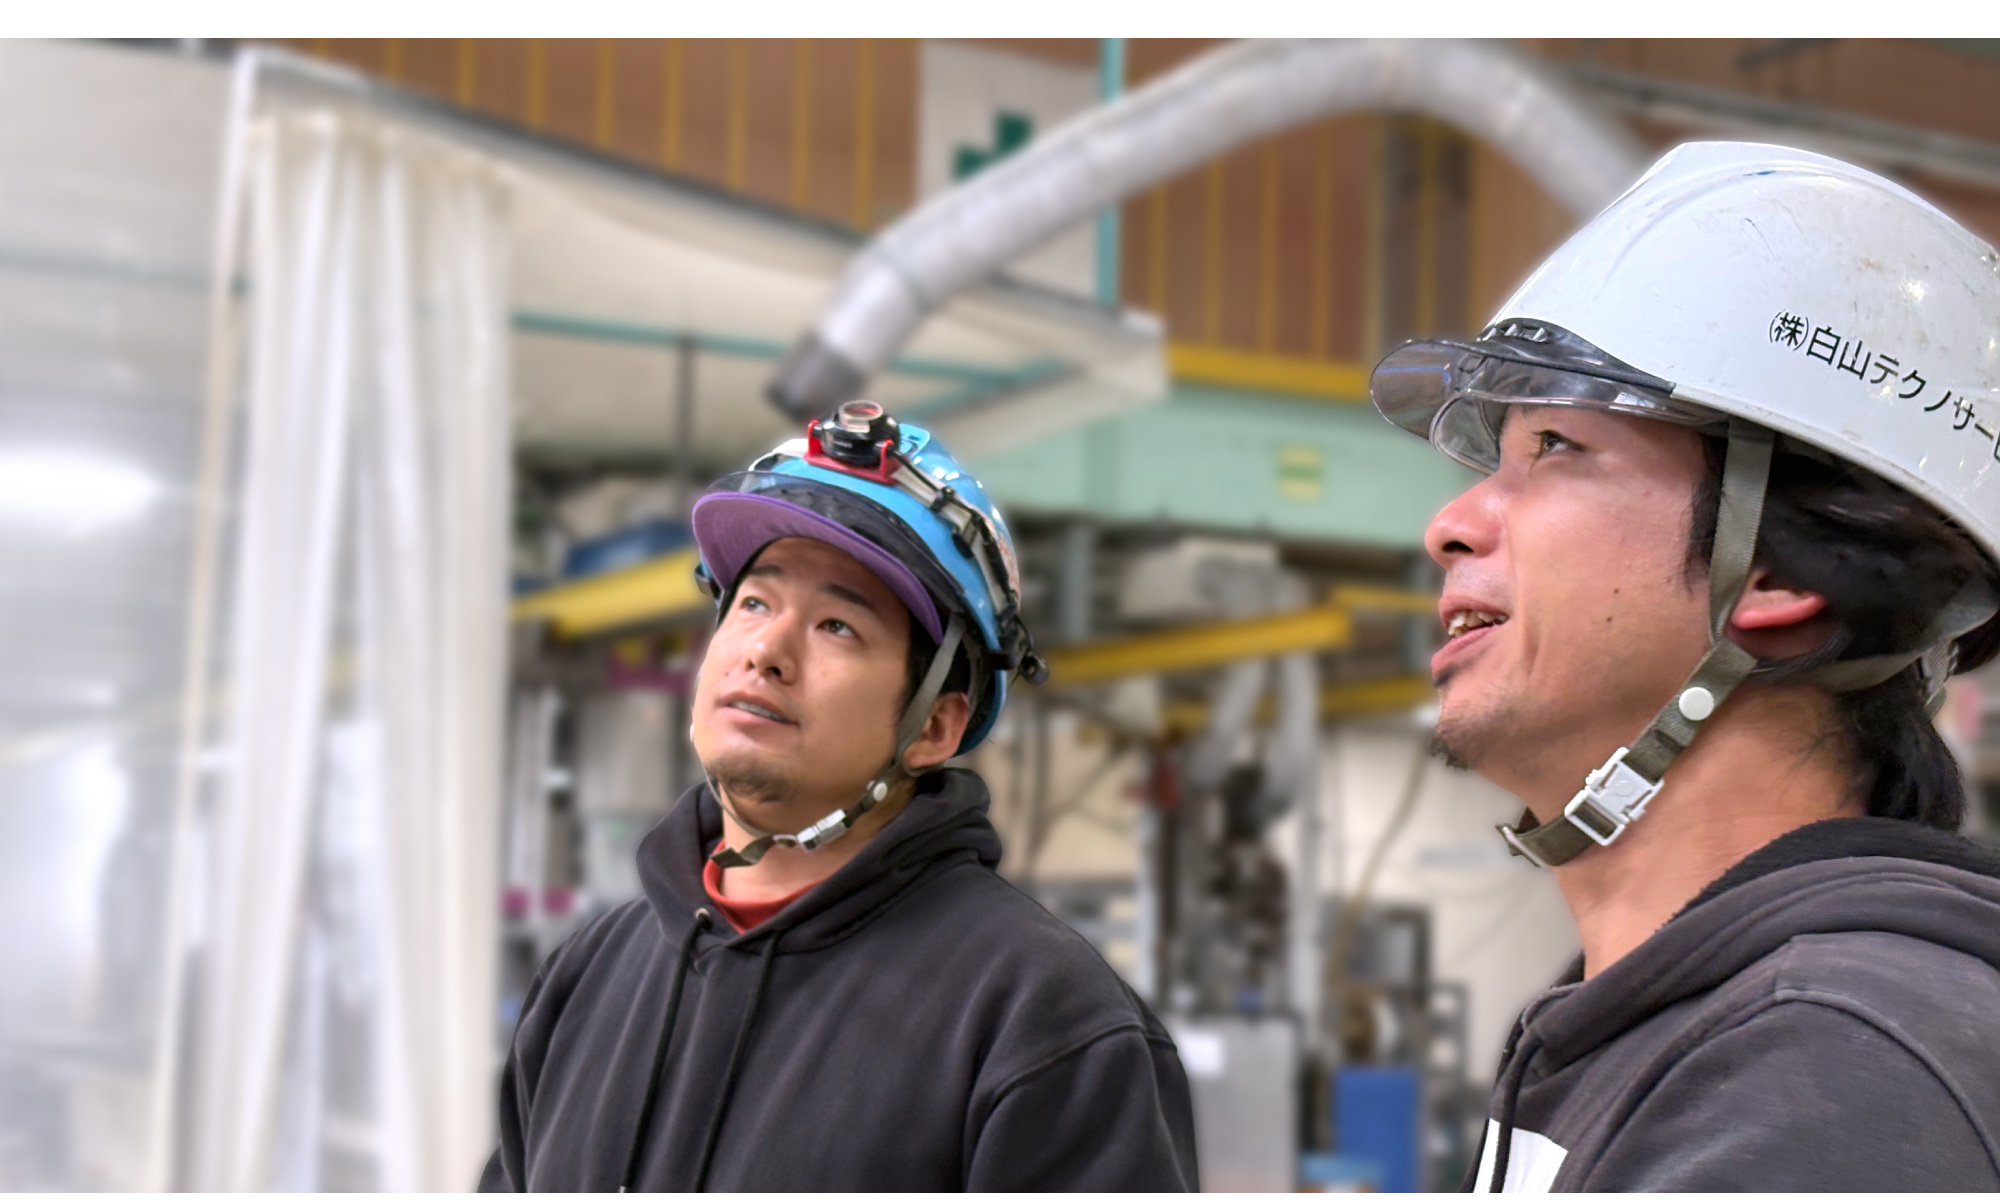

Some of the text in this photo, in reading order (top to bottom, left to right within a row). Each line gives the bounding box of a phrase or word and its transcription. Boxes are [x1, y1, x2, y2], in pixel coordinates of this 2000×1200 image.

[1769, 309, 2000, 462] (株)白山テクノサー
